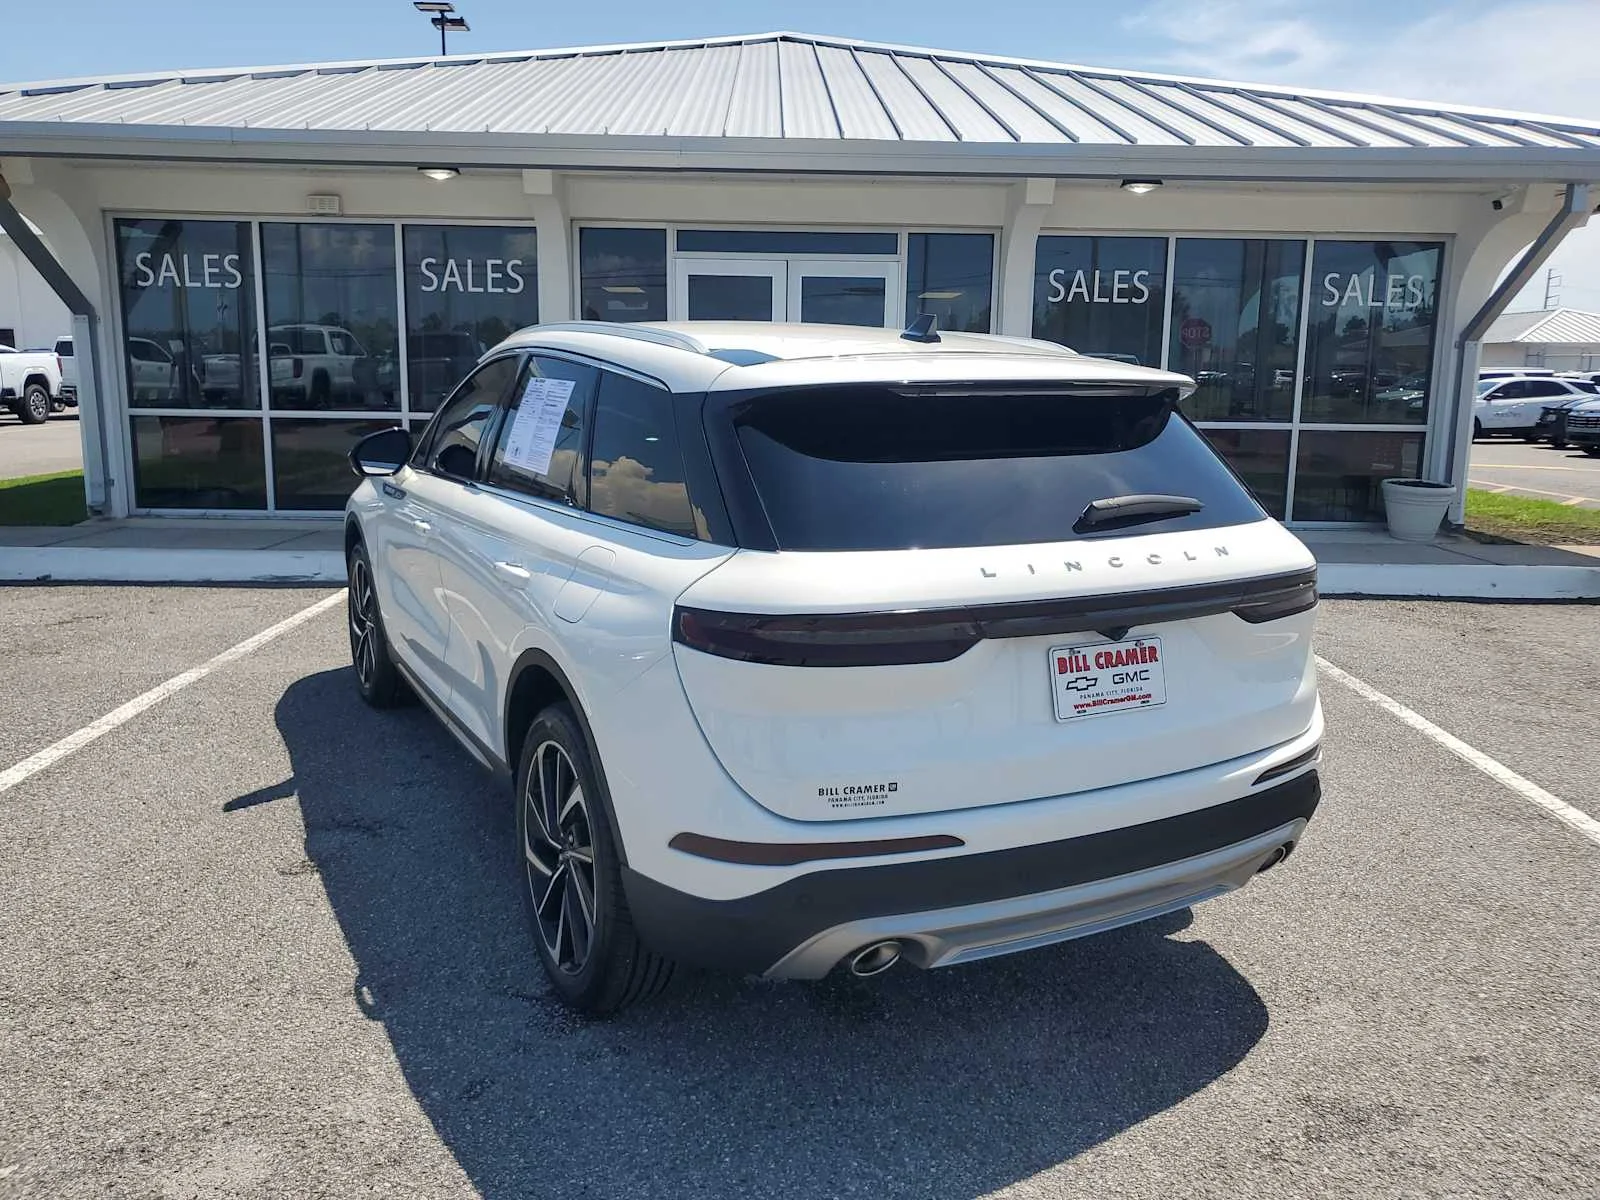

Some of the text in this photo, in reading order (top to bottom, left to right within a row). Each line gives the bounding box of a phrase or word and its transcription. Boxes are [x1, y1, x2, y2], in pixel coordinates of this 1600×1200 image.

[135, 252, 242, 289] SALES
[420, 257, 526, 294] SALES
[1048, 268, 1150, 304] SALES
[1322, 272, 1424, 307] SALES
[980, 546, 1229, 578] LINCOLN
[1057, 645, 1159, 675] BILL CRAMER
[1112, 669, 1150, 685] GMC
[1073, 693, 1152, 709] www.BillCramerGM.com
[1080, 692, 1104, 700] PANAMA
[818, 787, 840, 797] BILL
[843, 784, 886, 795] CRAMER
